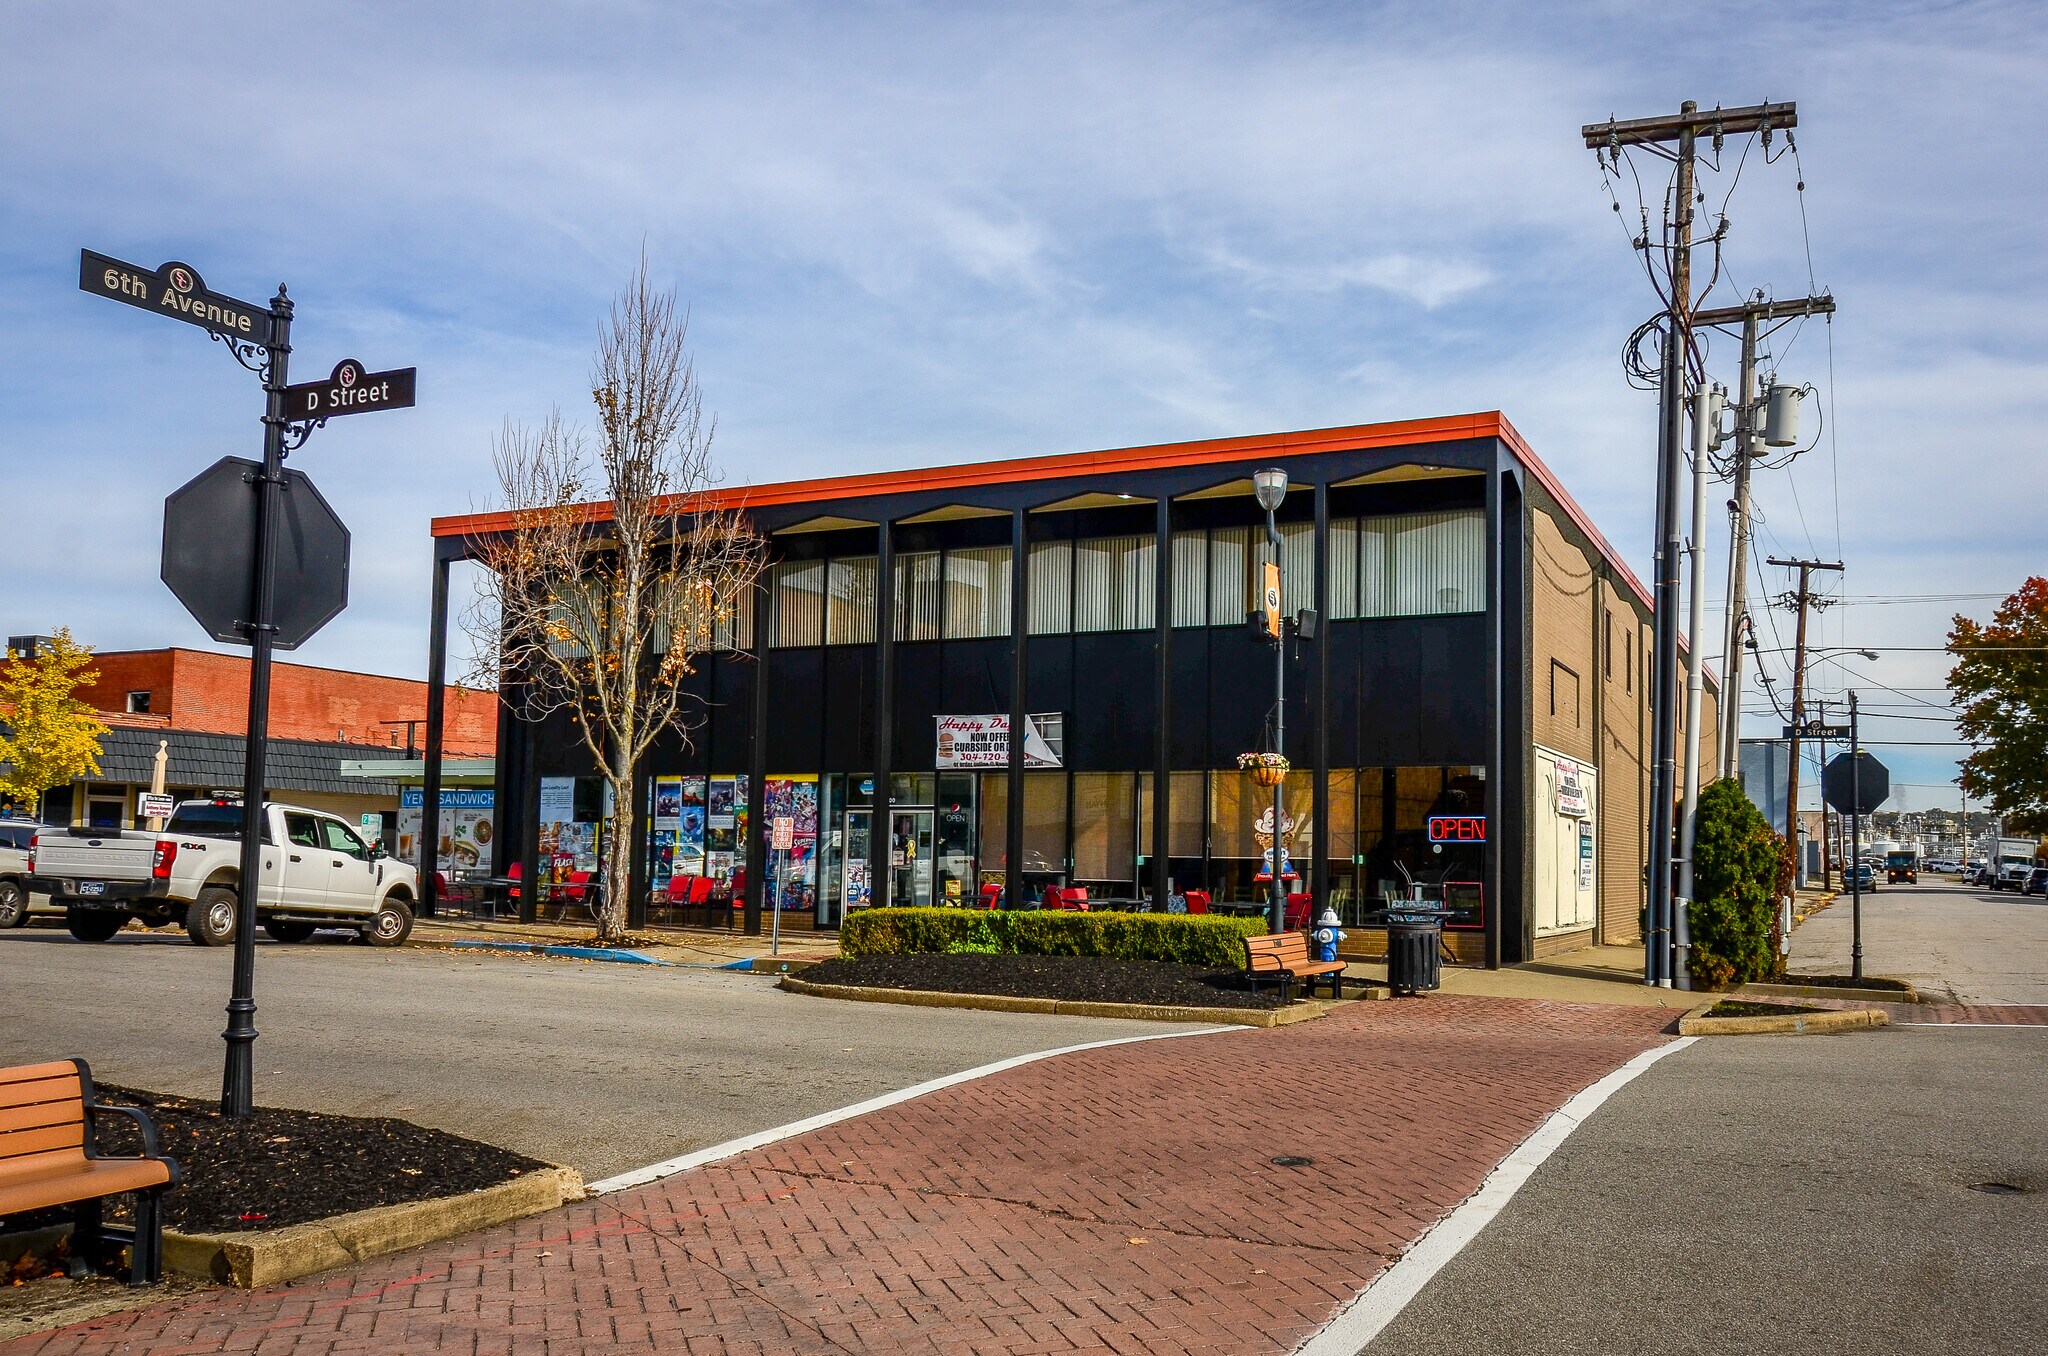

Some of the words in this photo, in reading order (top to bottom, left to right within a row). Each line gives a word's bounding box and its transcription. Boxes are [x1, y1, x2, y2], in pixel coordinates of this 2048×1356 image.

[104, 269, 147, 299] 6th
[161, 288, 251, 332] Avenue
[307, 392, 318, 411] D
[330, 381, 389, 407] Street
[939, 717, 983, 732] Happy
[970, 732, 988, 742] NOW
[1807, 728, 1837, 736] Street
[954, 742, 992, 752] CURBSIDE
[993, 742, 1005, 752] OR
[439, 793, 494, 805] SANDWICH
[946, 814, 965, 822] OPEN
[1431, 819, 1486, 839] OPEN
